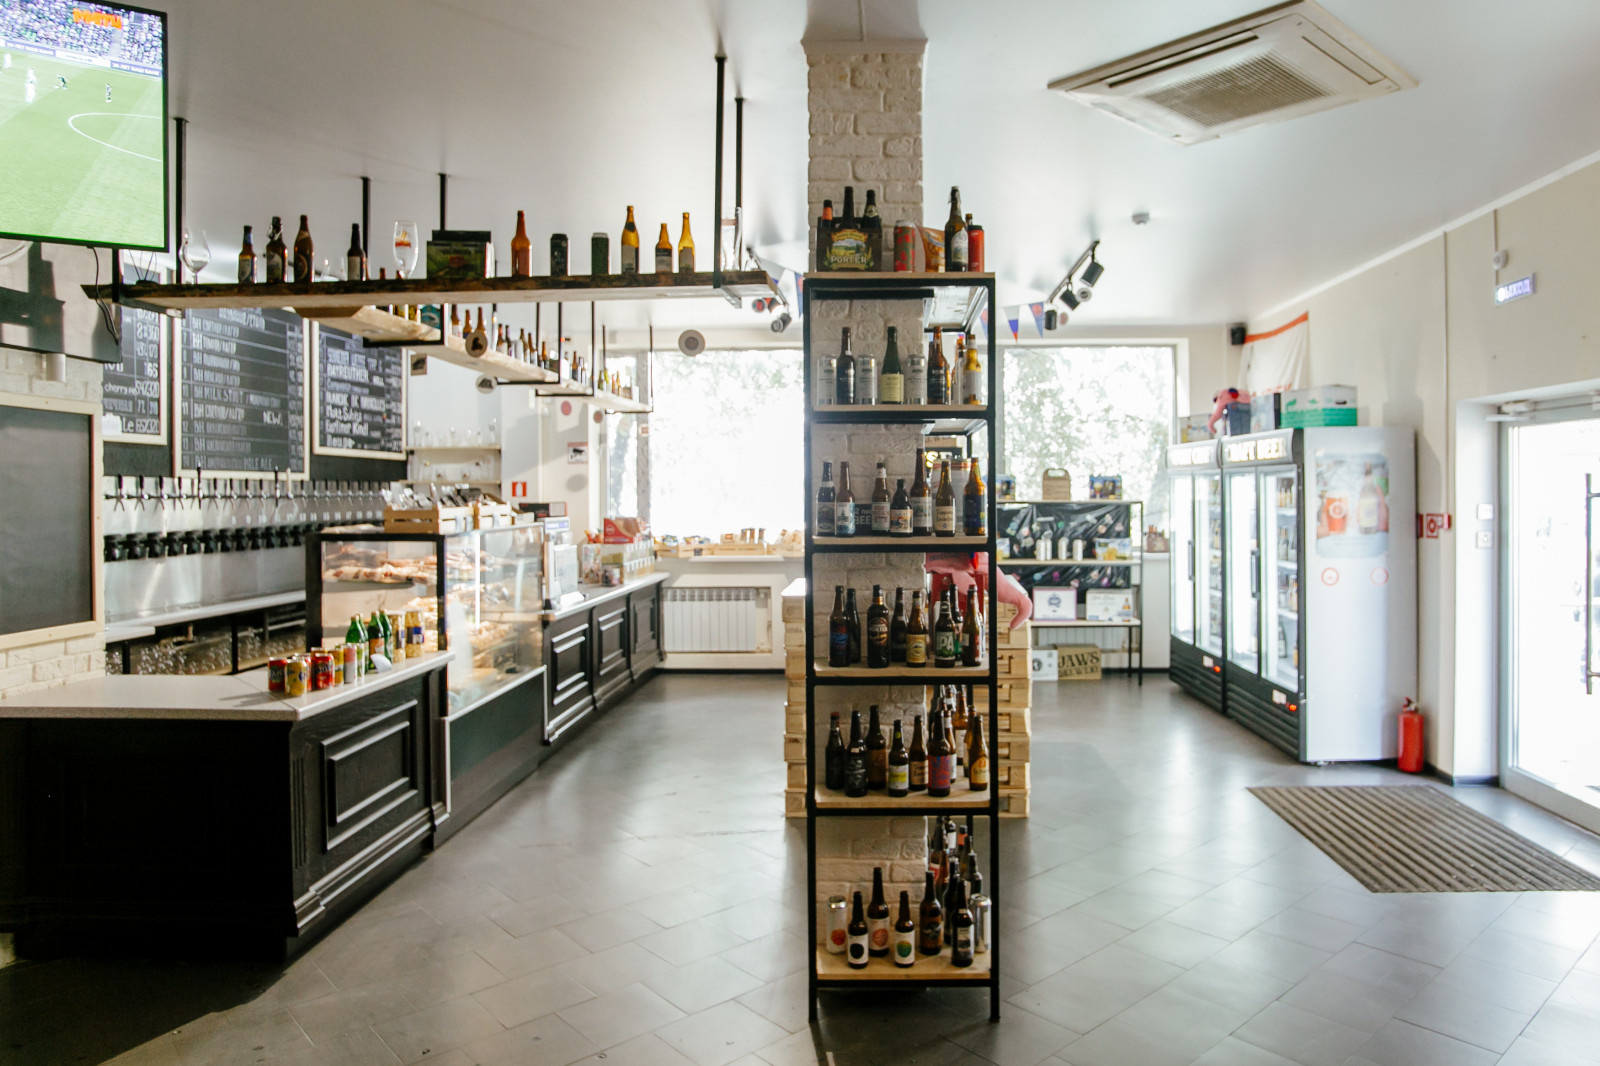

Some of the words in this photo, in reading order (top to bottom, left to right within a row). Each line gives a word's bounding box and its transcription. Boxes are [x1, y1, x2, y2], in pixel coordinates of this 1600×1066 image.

[830, 255, 867, 264] PORTER
[936, 635, 955, 651] IPA
[1058, 651, 1100, 668] JAWS
